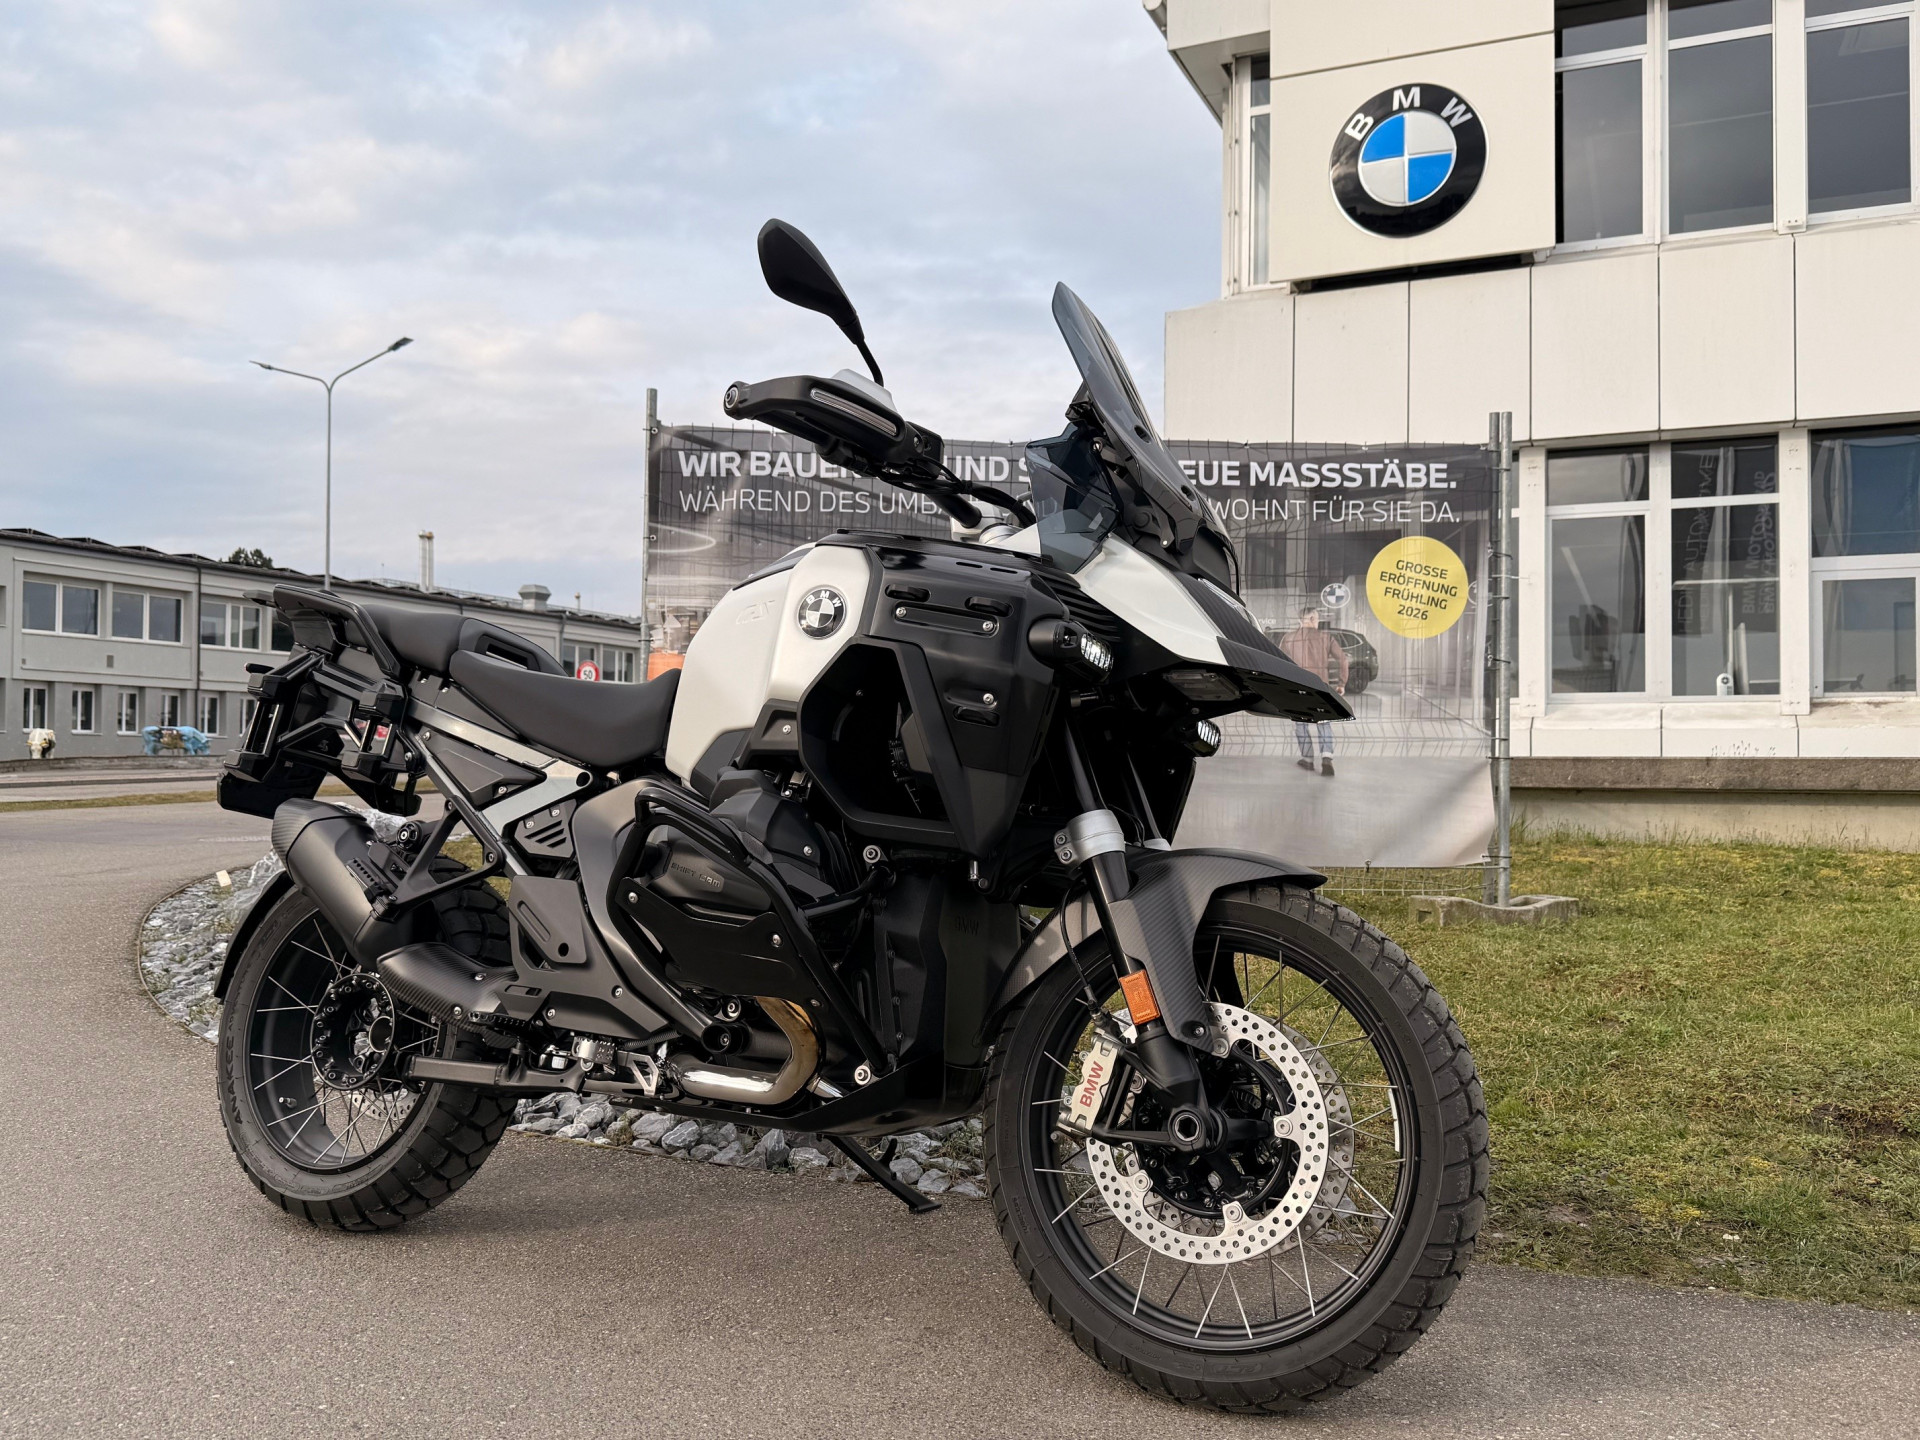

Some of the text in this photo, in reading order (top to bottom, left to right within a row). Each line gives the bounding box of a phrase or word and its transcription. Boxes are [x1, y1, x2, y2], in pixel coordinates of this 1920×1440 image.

[1344, 86, 1474, 142] BMW
[678, 451, 742, 478] WIR
[1178, 460, 1241, 487] EUE
[1249, 458, 1457, 489] MASSSTÄBE.
[679, 485, 1460, 523] WÄHREND DES UMB WOHNT FÜR SIE DA.
[1396, 559, 1449, 580] GROSSE
[1380, 571, 1458, 597] ERÖFFNUNG
[805, 590, 843, 608] BMW
[1384, 586, 1448, 610] FRÜHLING
[1397, 604, 1429, 621] 2026
[583, 669, 593, 680] 50
[225, 1036, 243, 1125] ANAKEE
[1080, 1061, 1104, 1108] BMW
